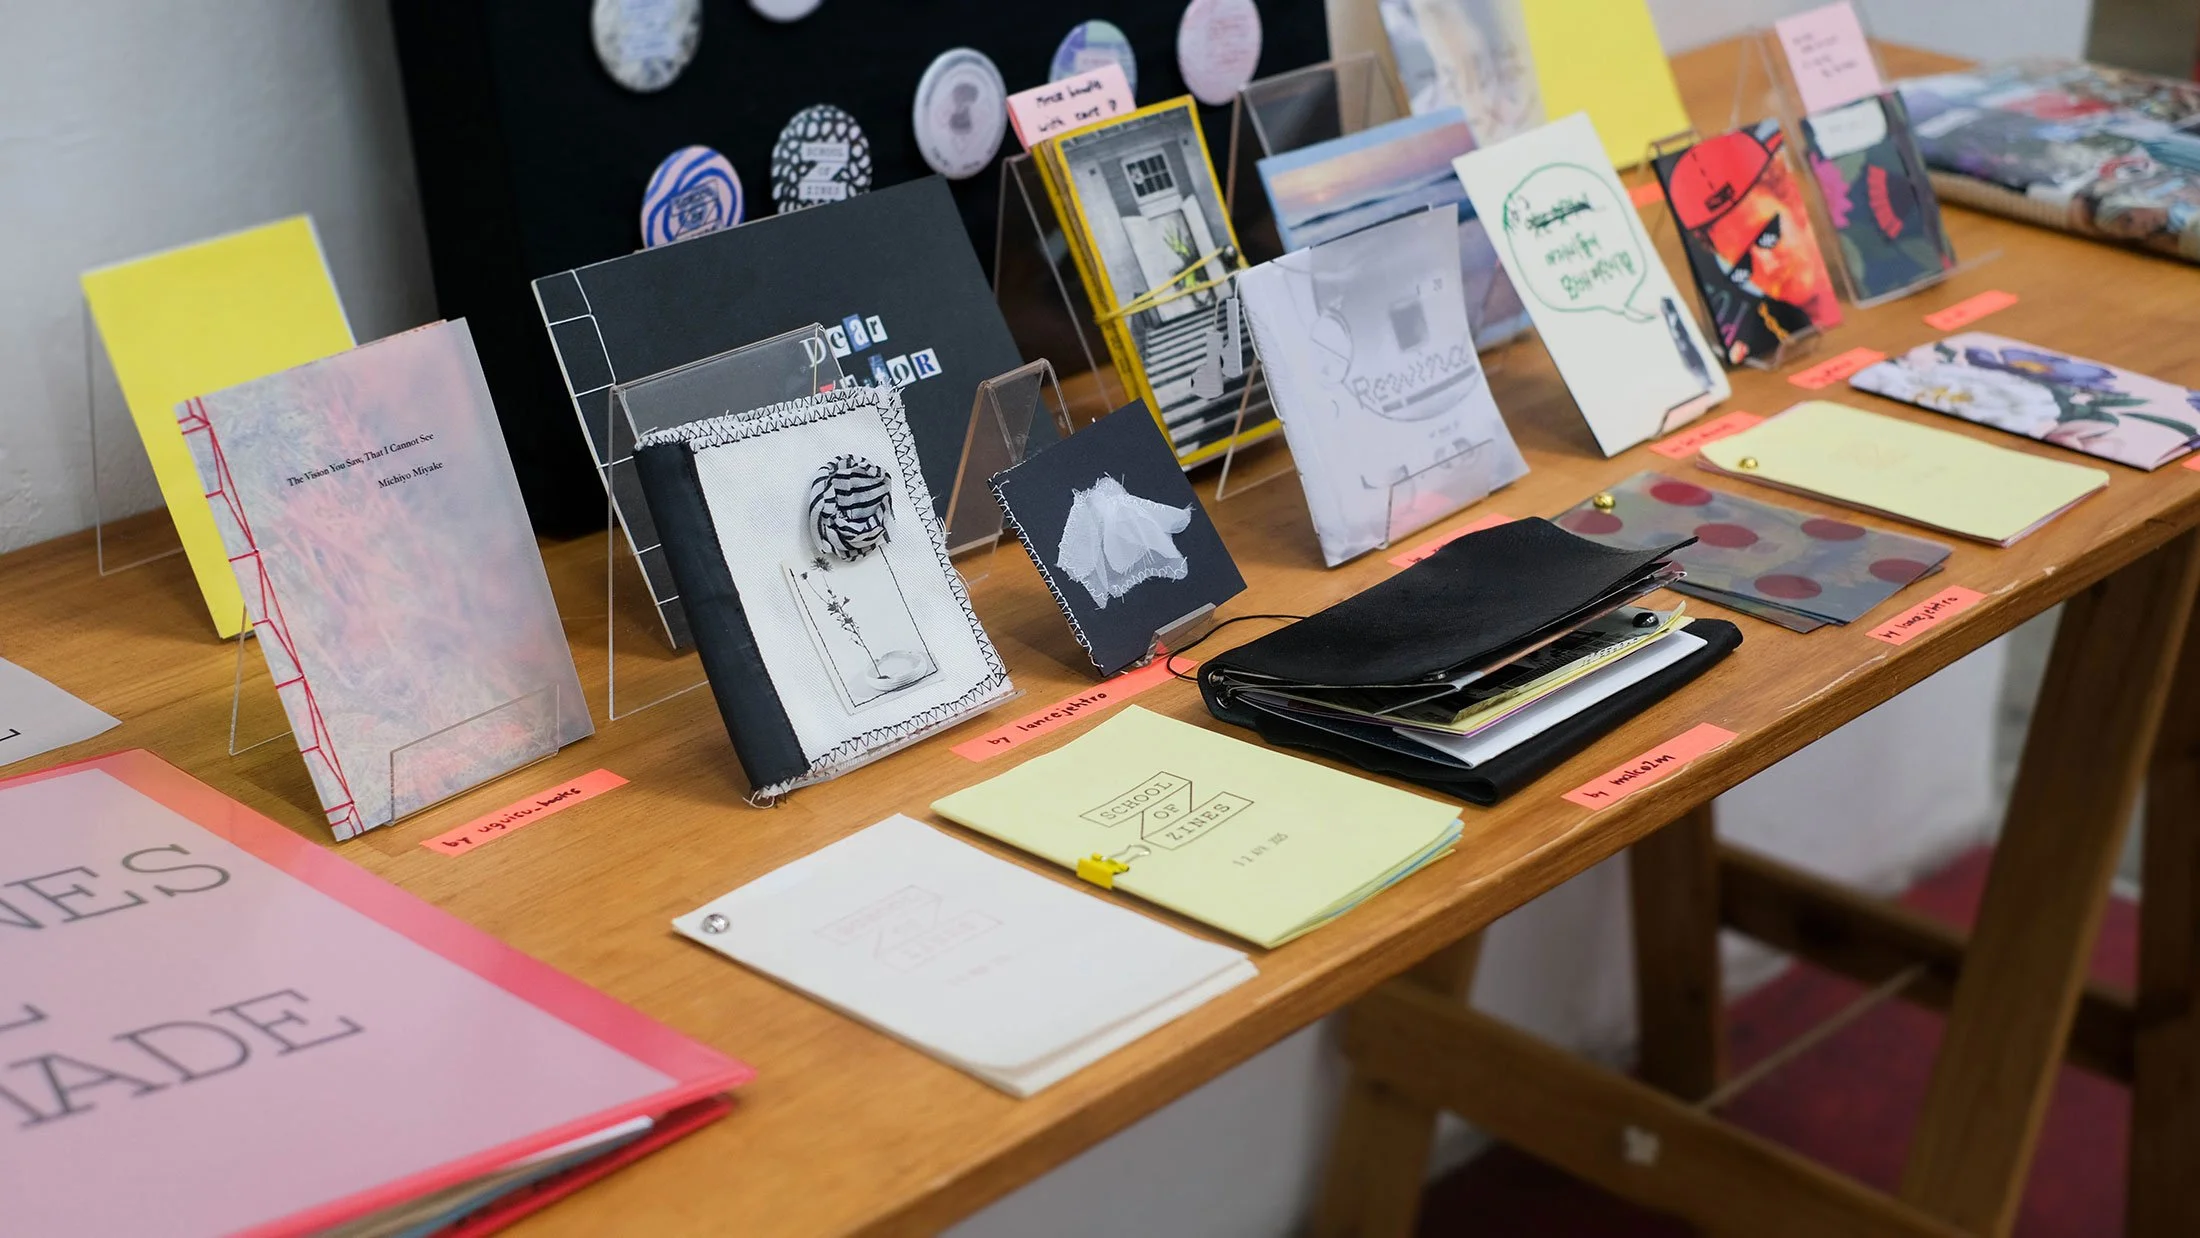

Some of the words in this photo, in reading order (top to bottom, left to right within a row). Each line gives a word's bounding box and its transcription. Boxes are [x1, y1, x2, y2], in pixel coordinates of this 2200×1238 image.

[799, 316, 882, 368] Dear
[287, 477, 304, 487] The
[304, 468, 329, 481] Vision
[329, 462, 346, 473] You
[346, 456, 364, 467] Saw,
[364, 450, 384, 461] That
[390, 438, 419, 453] Cannot
[419, 432, 435, 443] See
[378, 472, 411, 489] Michiyo
[412, 461, 443, 477] Miyake
[987, 735, 1011, 745] by
[1100, 781, 1173, 820] SCHOOL
[1583, 790, 1610, 799] by
[1153, 803, 1180, 820] OF
[1166, 803, 1230, 841] ZINES
[442, 837, 473, 848] by
[0, 843, 231, 931] ES
